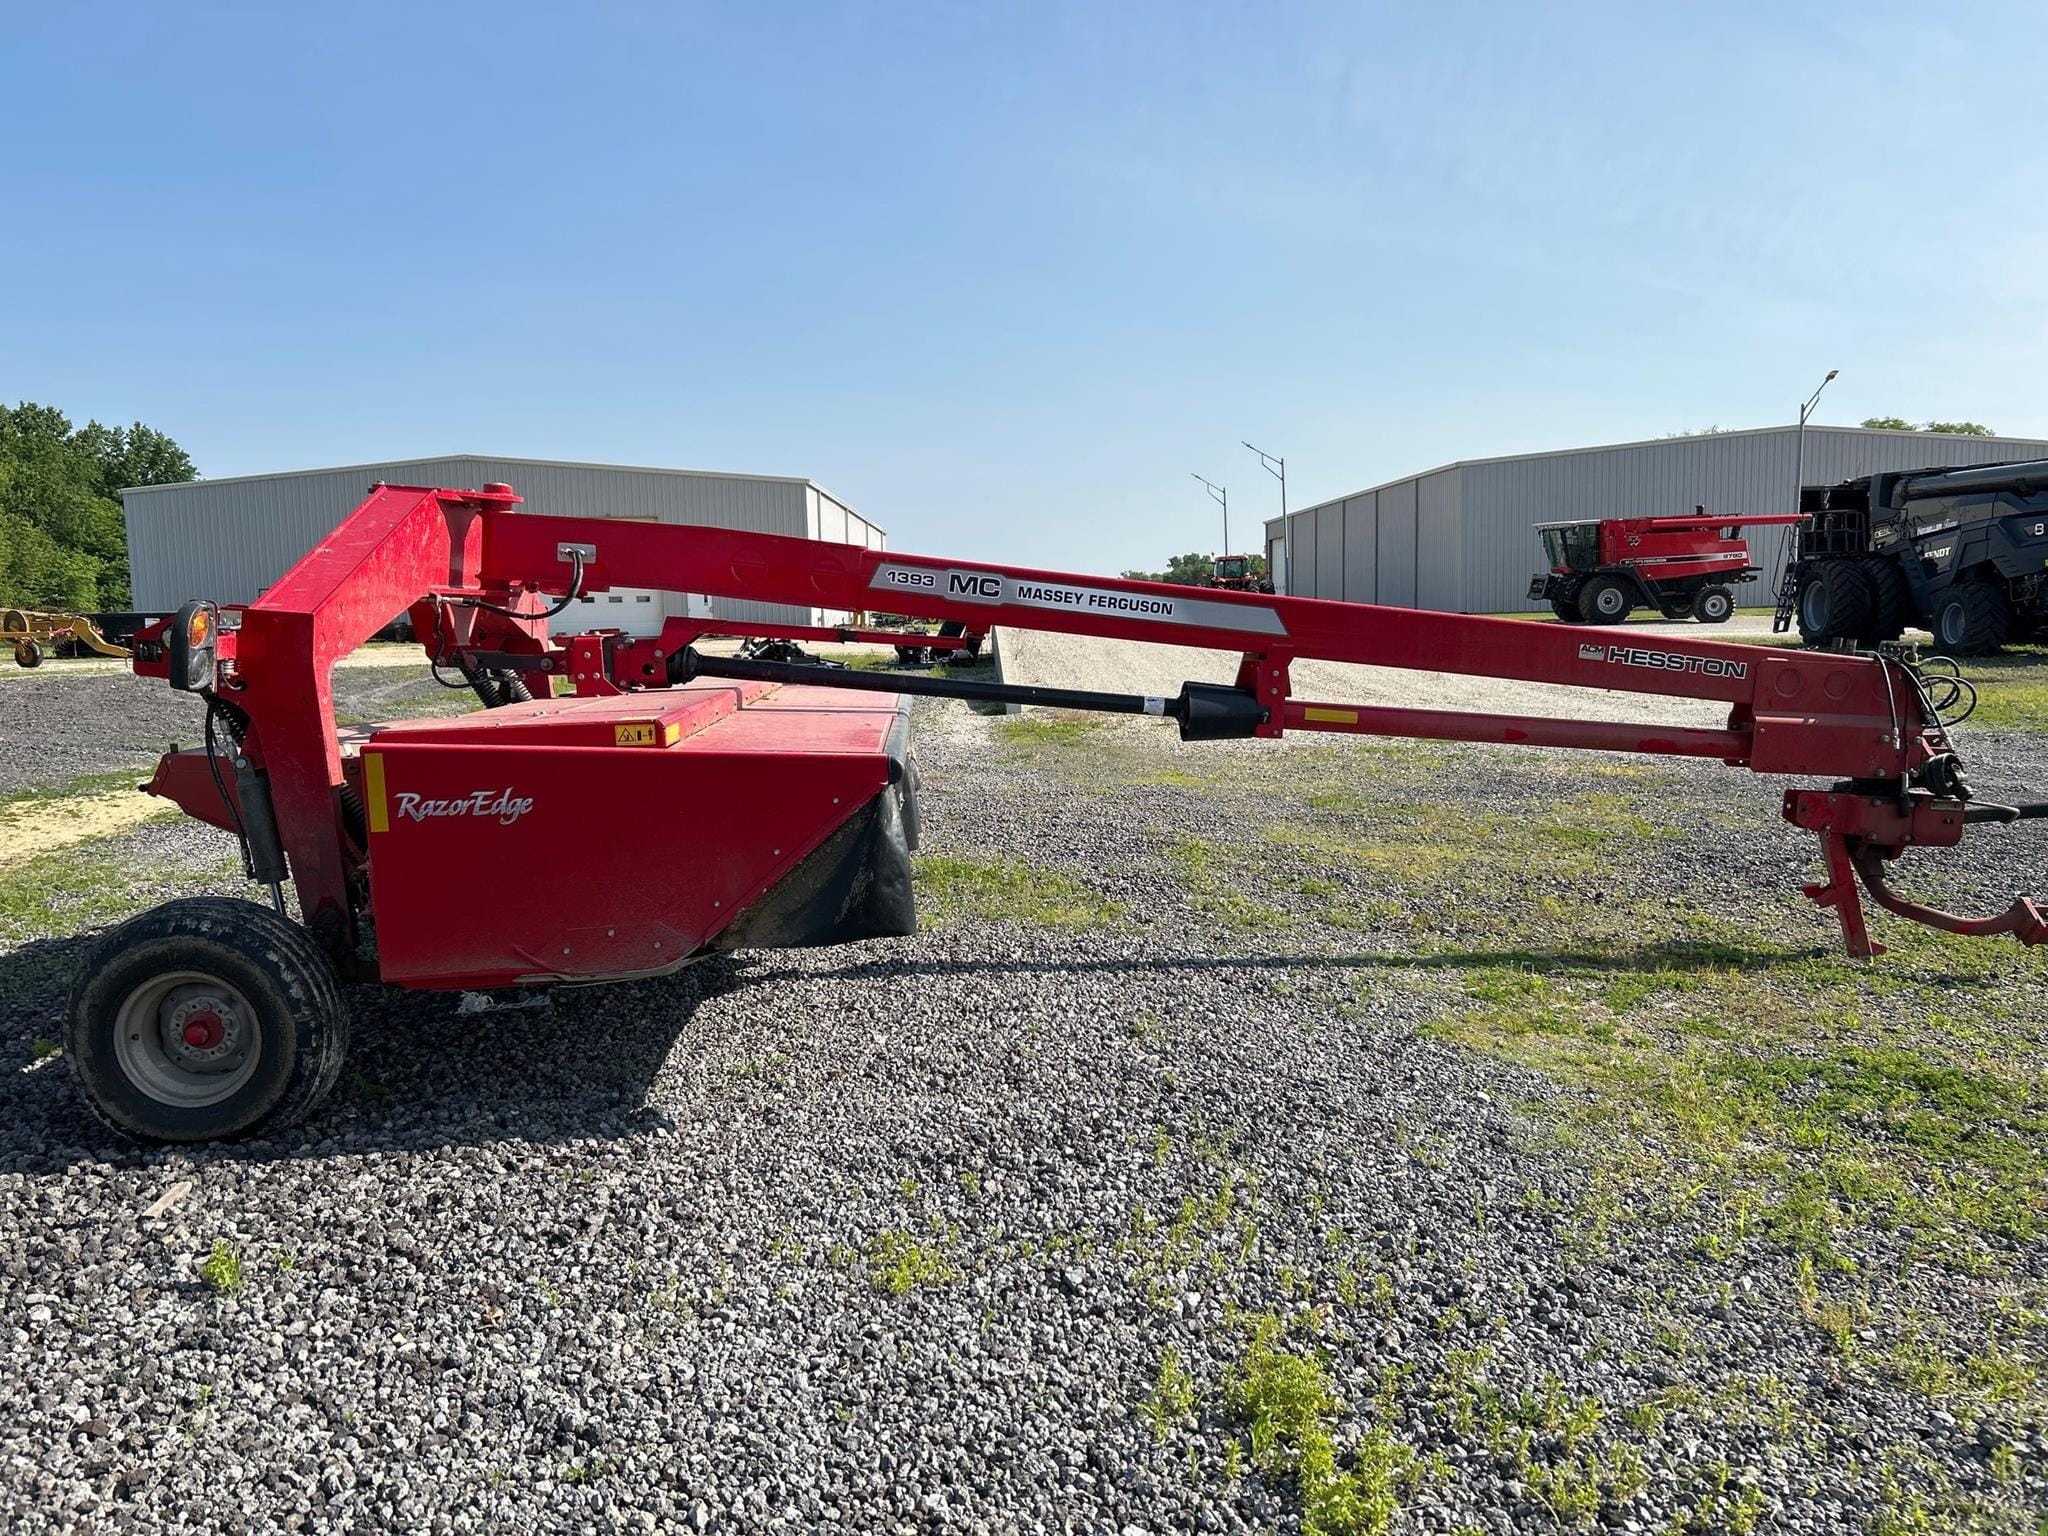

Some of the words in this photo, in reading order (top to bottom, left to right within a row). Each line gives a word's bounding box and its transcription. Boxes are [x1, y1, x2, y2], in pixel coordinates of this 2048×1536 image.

[886, 570, 937, 588] 1393
[948, 572, 1002, 599] MC
[1016, 585, 1085, 605] MASSEY
[1088, 594, 1175, 616] FERGUSON
[1606, 645, 1748, 680] HESSTON
[393, 786, 534, 826] RazorEdge
